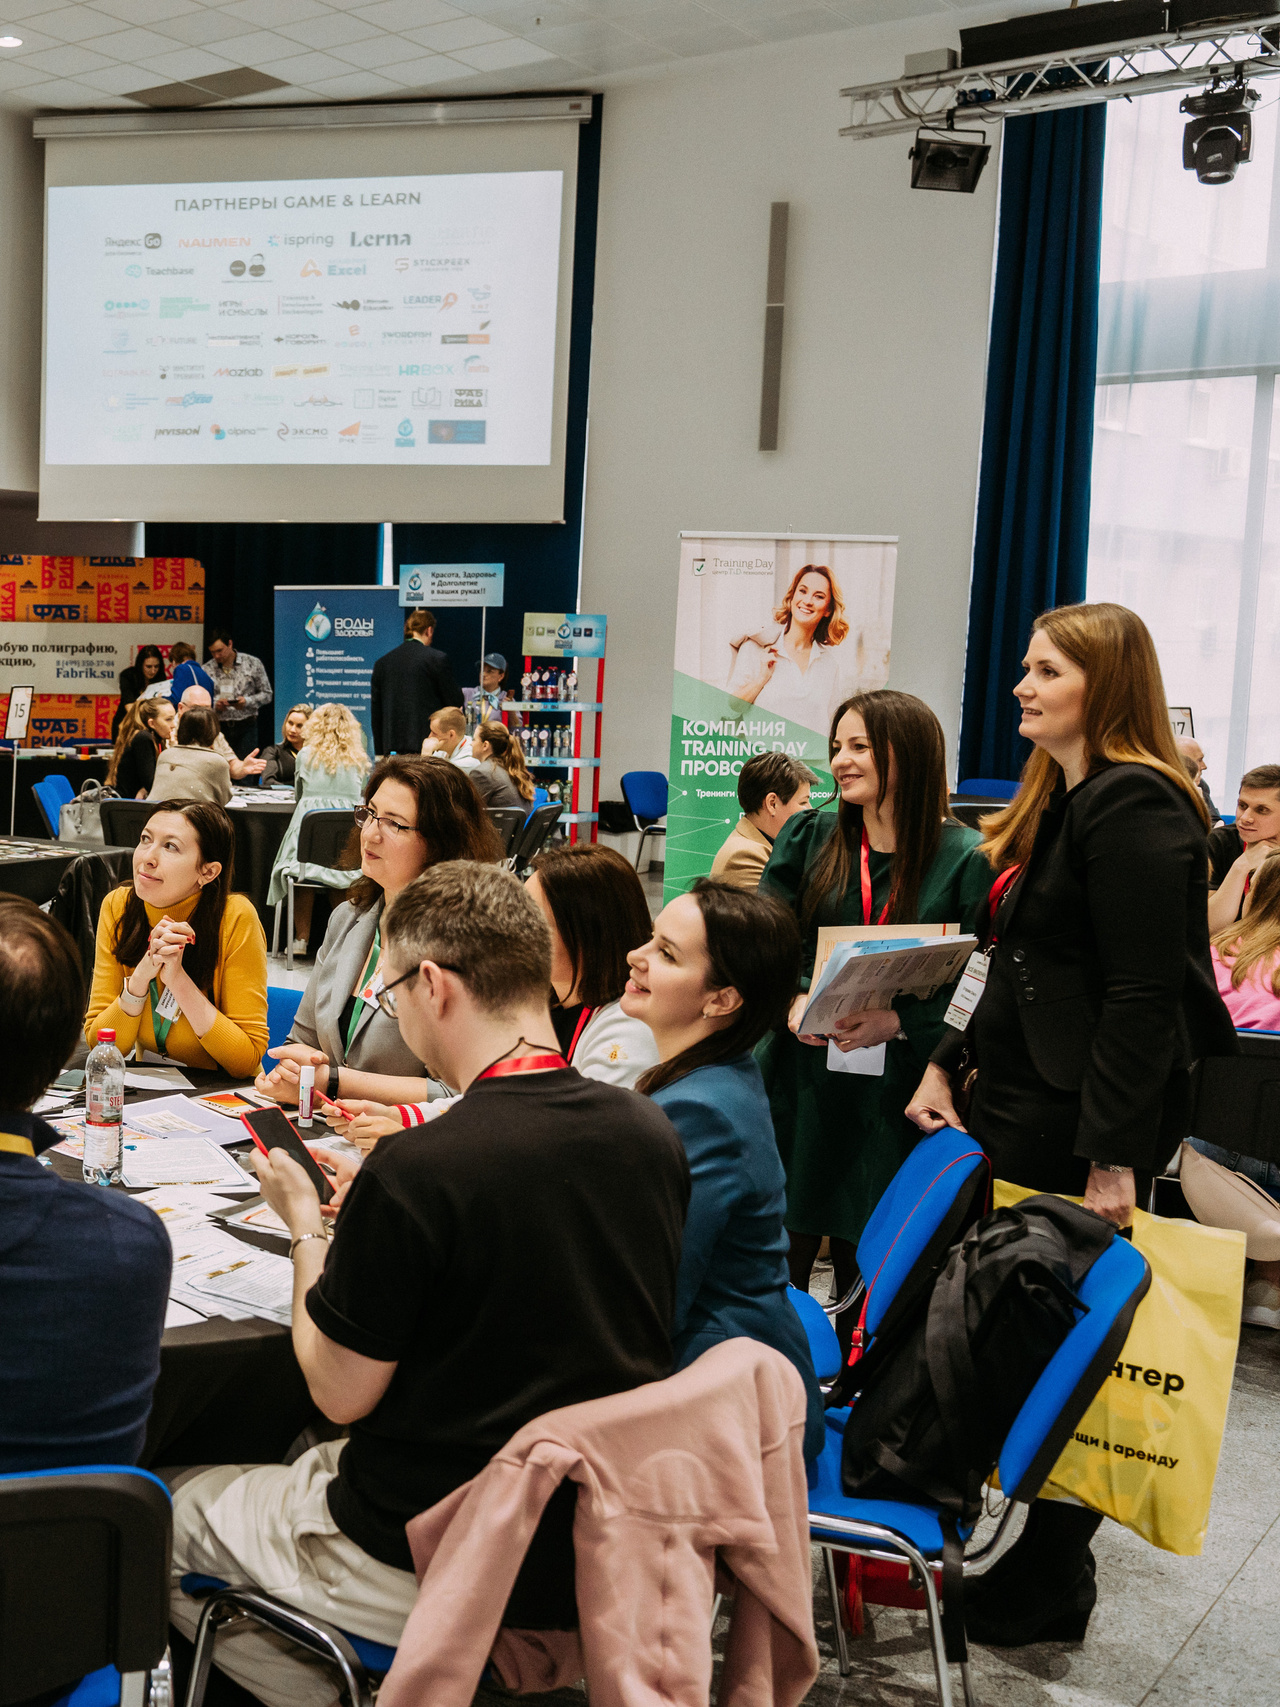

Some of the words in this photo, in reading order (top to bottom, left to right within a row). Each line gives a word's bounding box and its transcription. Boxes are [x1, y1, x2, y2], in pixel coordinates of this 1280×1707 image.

[175, 197, 277, 211] ПАРТНЕРЫ
[283, 195, 337, 209] GAME
[342, 195, 354, 207] &
[360, 192, 421, 206] LEARN
[178, 237, 251, 249] NAUMEN
[284, 233, 334, 248] ispring
[350, 231, 411, 247] Lerna
[327, 264, 367, 276] Excel
[713, 558, 753, 569] Training
[755, 558, 774, 570] Day
[33, 604, 80, 620] ФАБ
[145, 606, 192, 621] ФАБ
[334, 618, 374, 630] ВОДЫ
[32, 642, 118, 656] полиграфию,
[56, 667, 115, 679] Fabrik.su
[14, 703, 26, 718] 15
[32, 719, 79, 734] ФАБ
[682, 720, 786, 737] КОМПАНИЯ
[681, 740, 767, 756] TRAINING
[772, 741, 808, 757] DAY
[680, 760, 743, 777] ПРОВО
[696, 789, 735, 799] Тренинги
[1103, 1440, 1110, 1451] в
[1113, 1444, 1179, 1469] аренду
